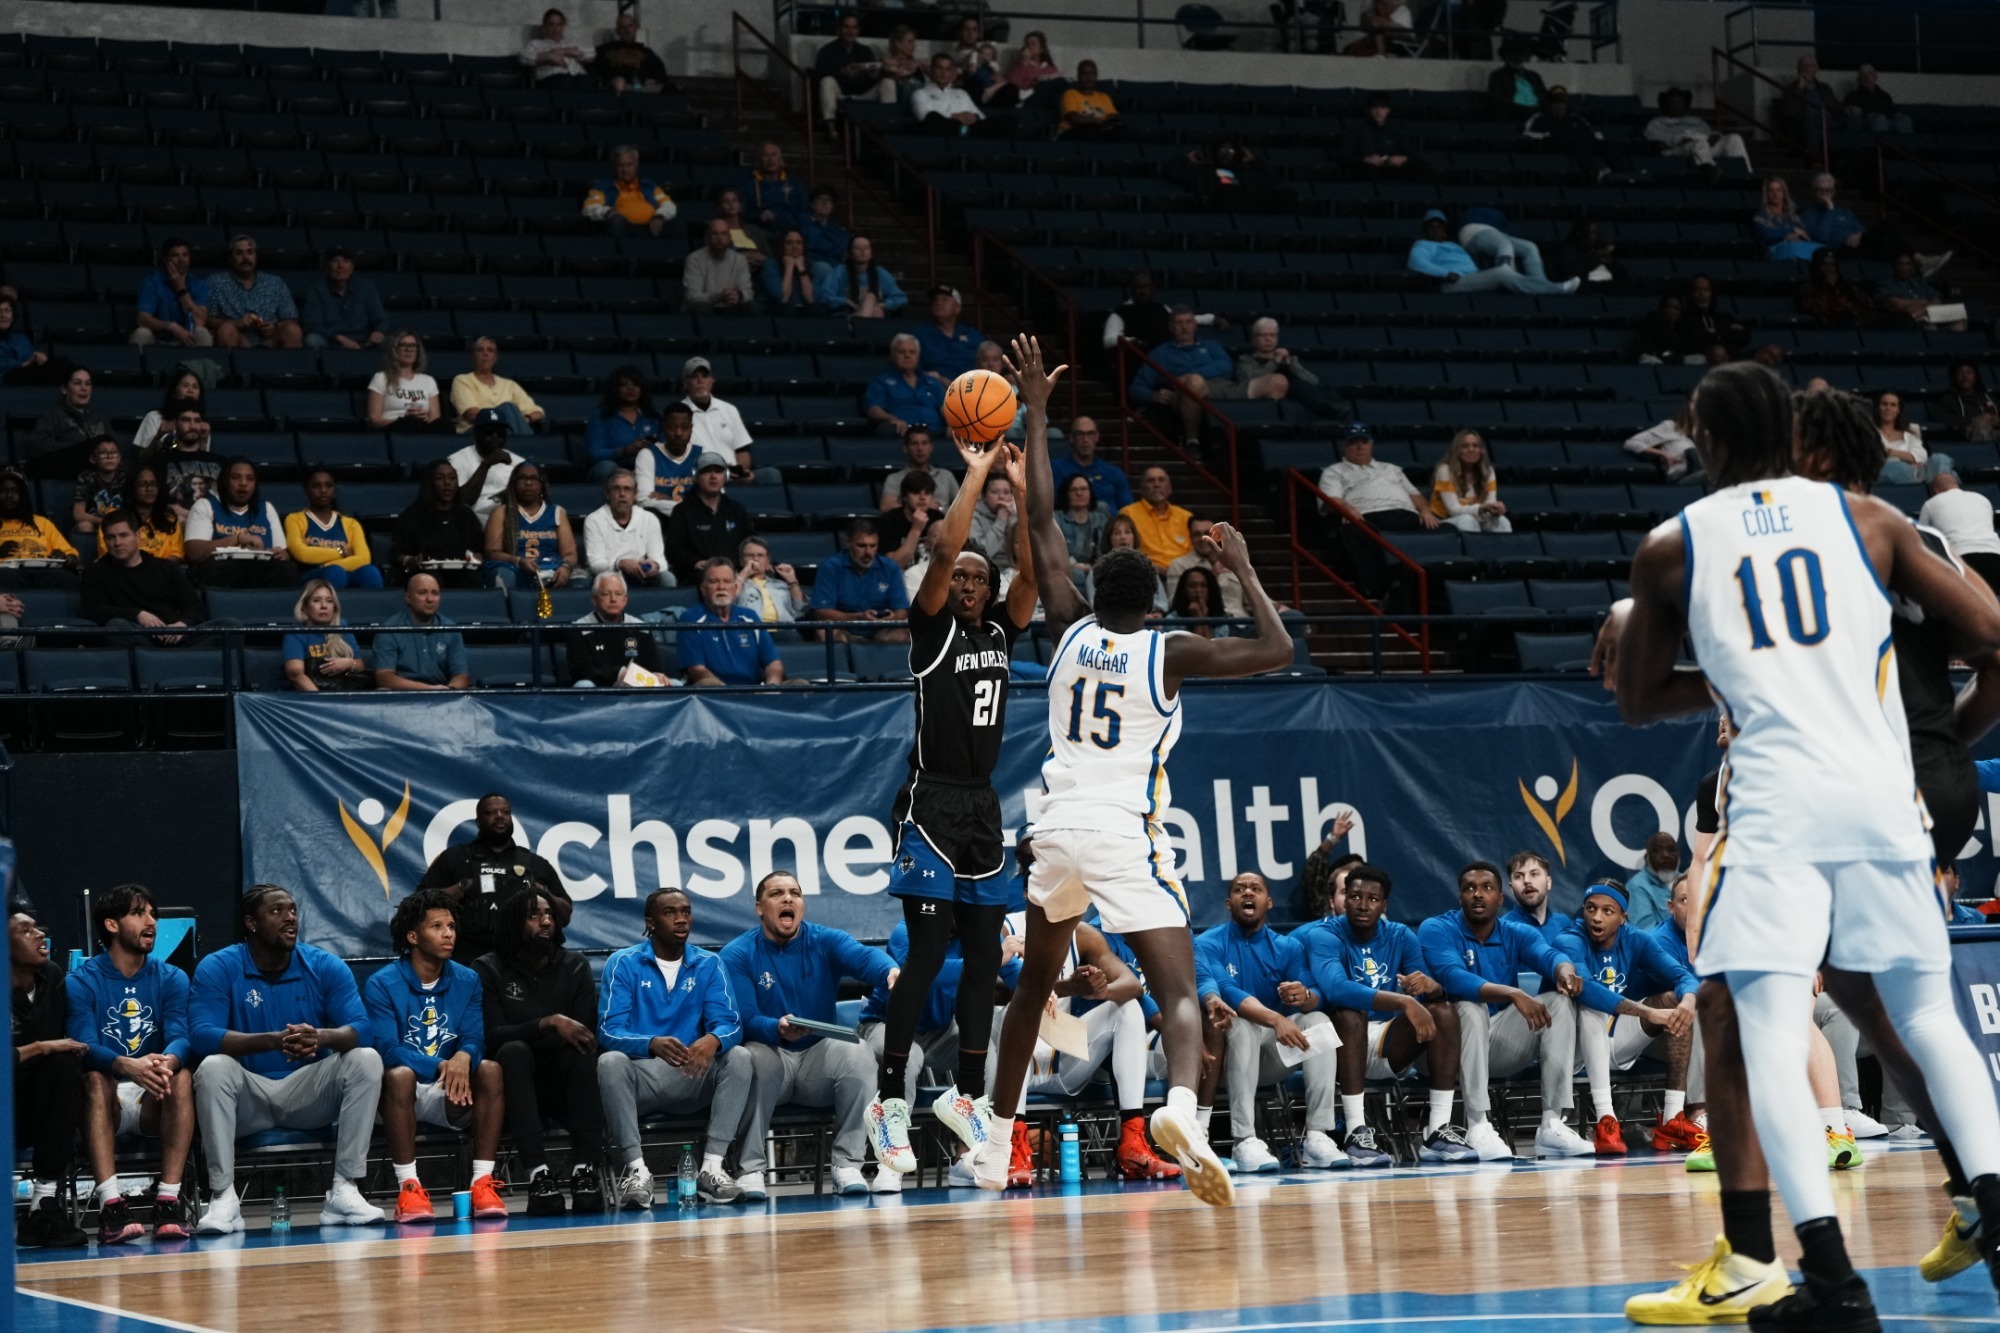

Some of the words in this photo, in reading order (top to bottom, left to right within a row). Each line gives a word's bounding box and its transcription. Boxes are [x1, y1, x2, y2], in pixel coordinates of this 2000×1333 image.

[1742, 505, 1793, 537] COLE
[525, 539, 540, 560] 6
[1734, 547, 1831, 652] 10
[954, 652, 979, 674] NEW
[1076, 643, 1129, 674] MACHAR
[973, 679, 1002, 727] 21
[1066, 675, 1125, 751] 15
[423, 793, 895, 901] Ochsne
[480, 867, 507, 875] POLICE
